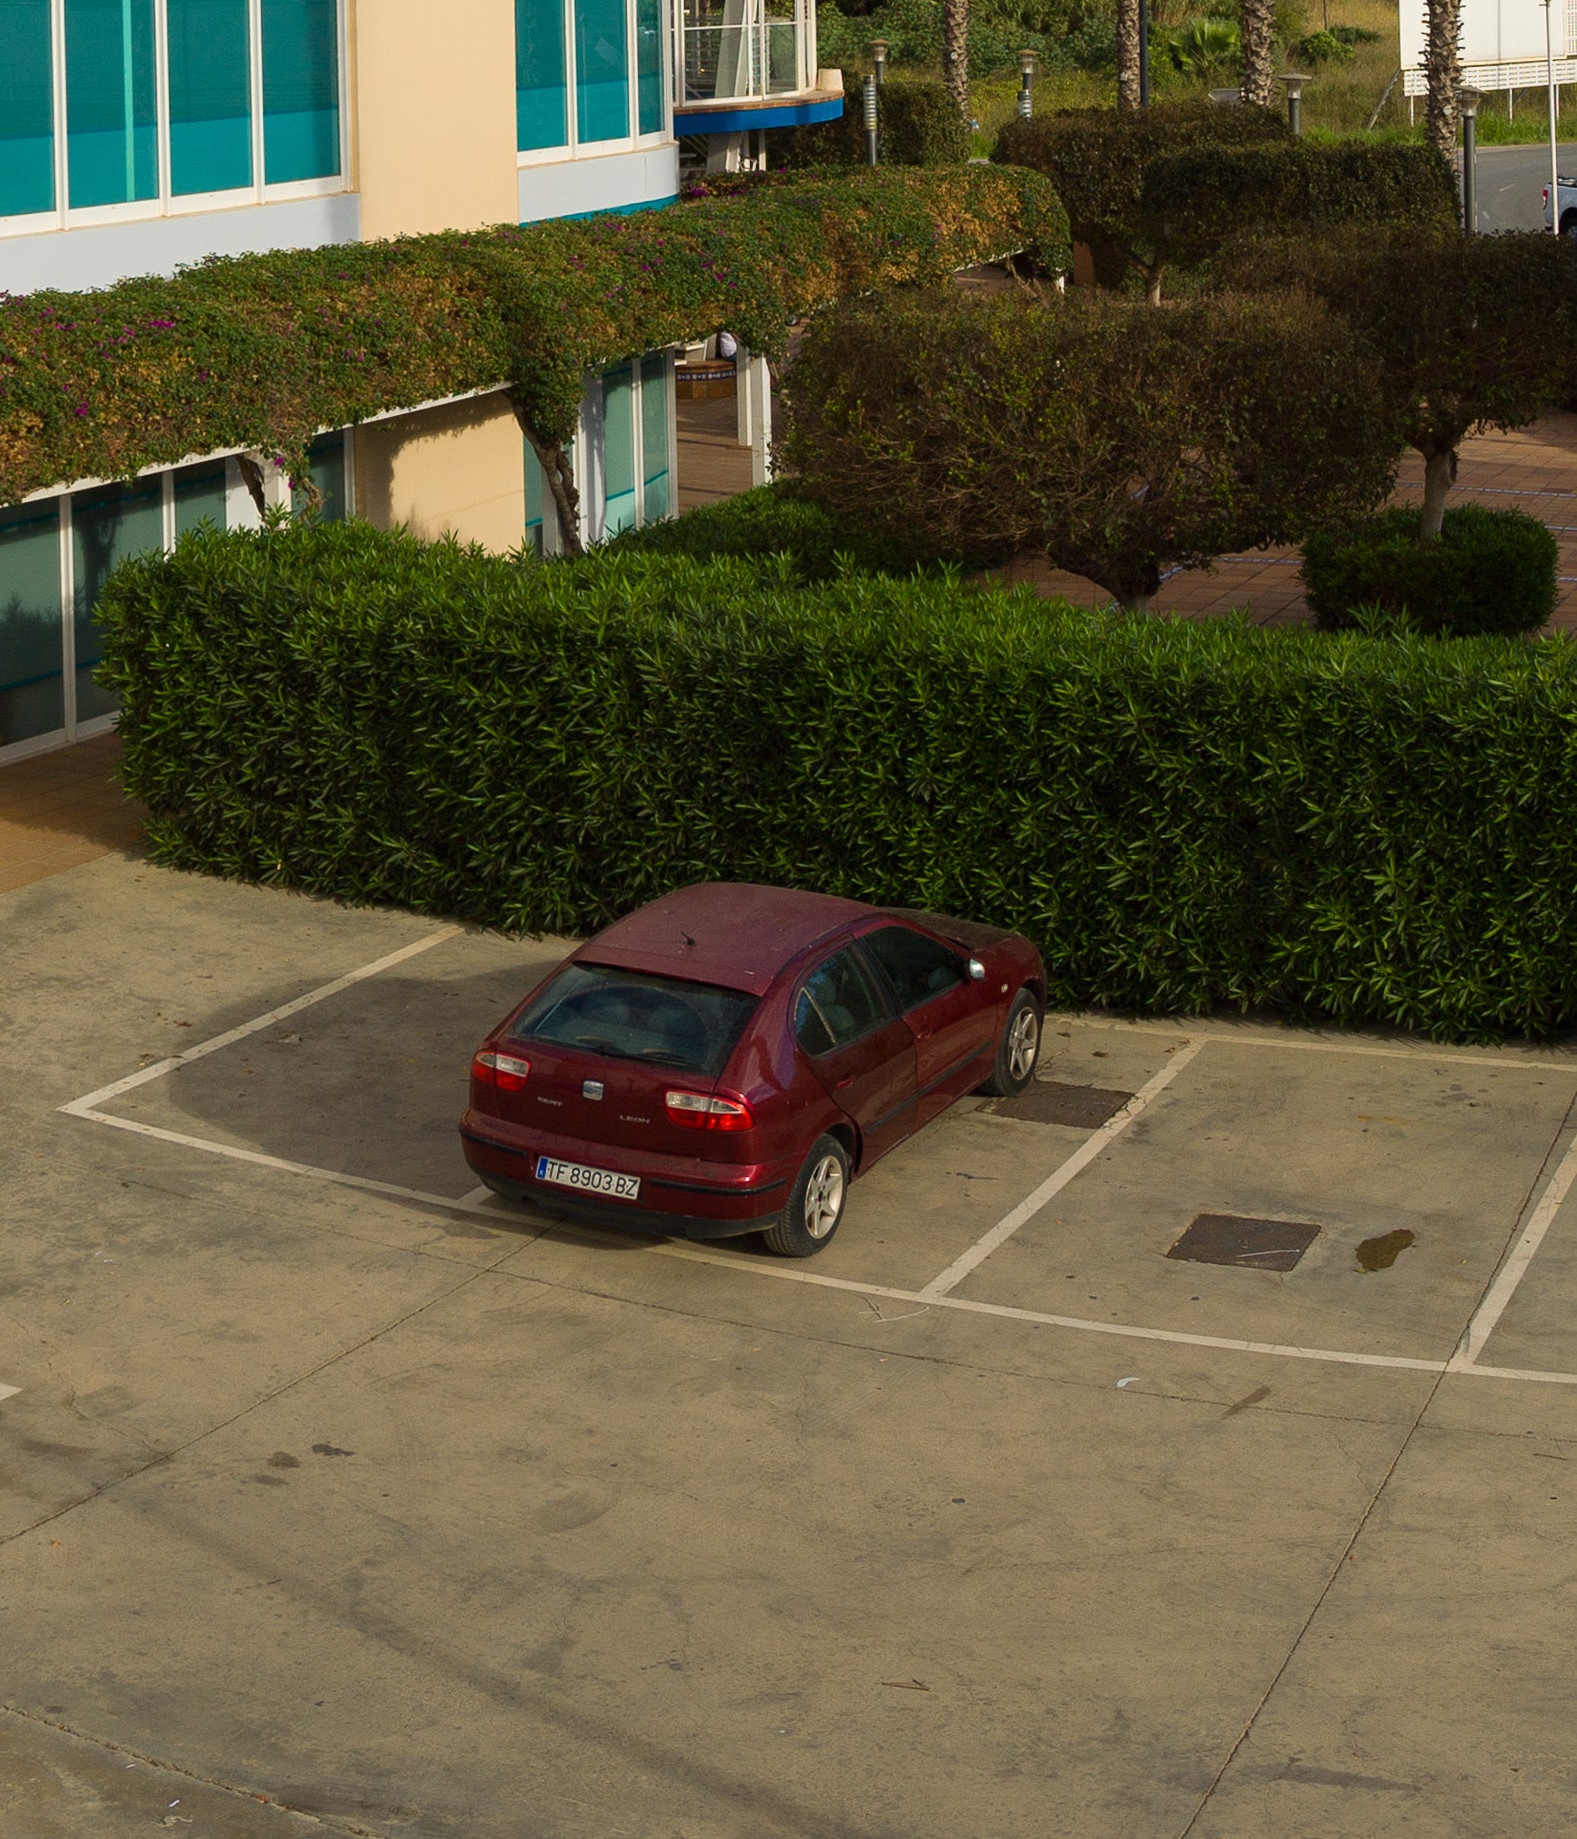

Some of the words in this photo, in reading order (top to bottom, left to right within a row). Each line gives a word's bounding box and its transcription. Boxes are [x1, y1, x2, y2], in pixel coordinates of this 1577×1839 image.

[537, 1096, 563, 1107] SEAT
[619, 1114, 650, 1124] LEON
[548, 1161, 568, 1180] TF
[570, 1167, 613, 1191] 8903
[615, 1176, 640, 1197] BZ
